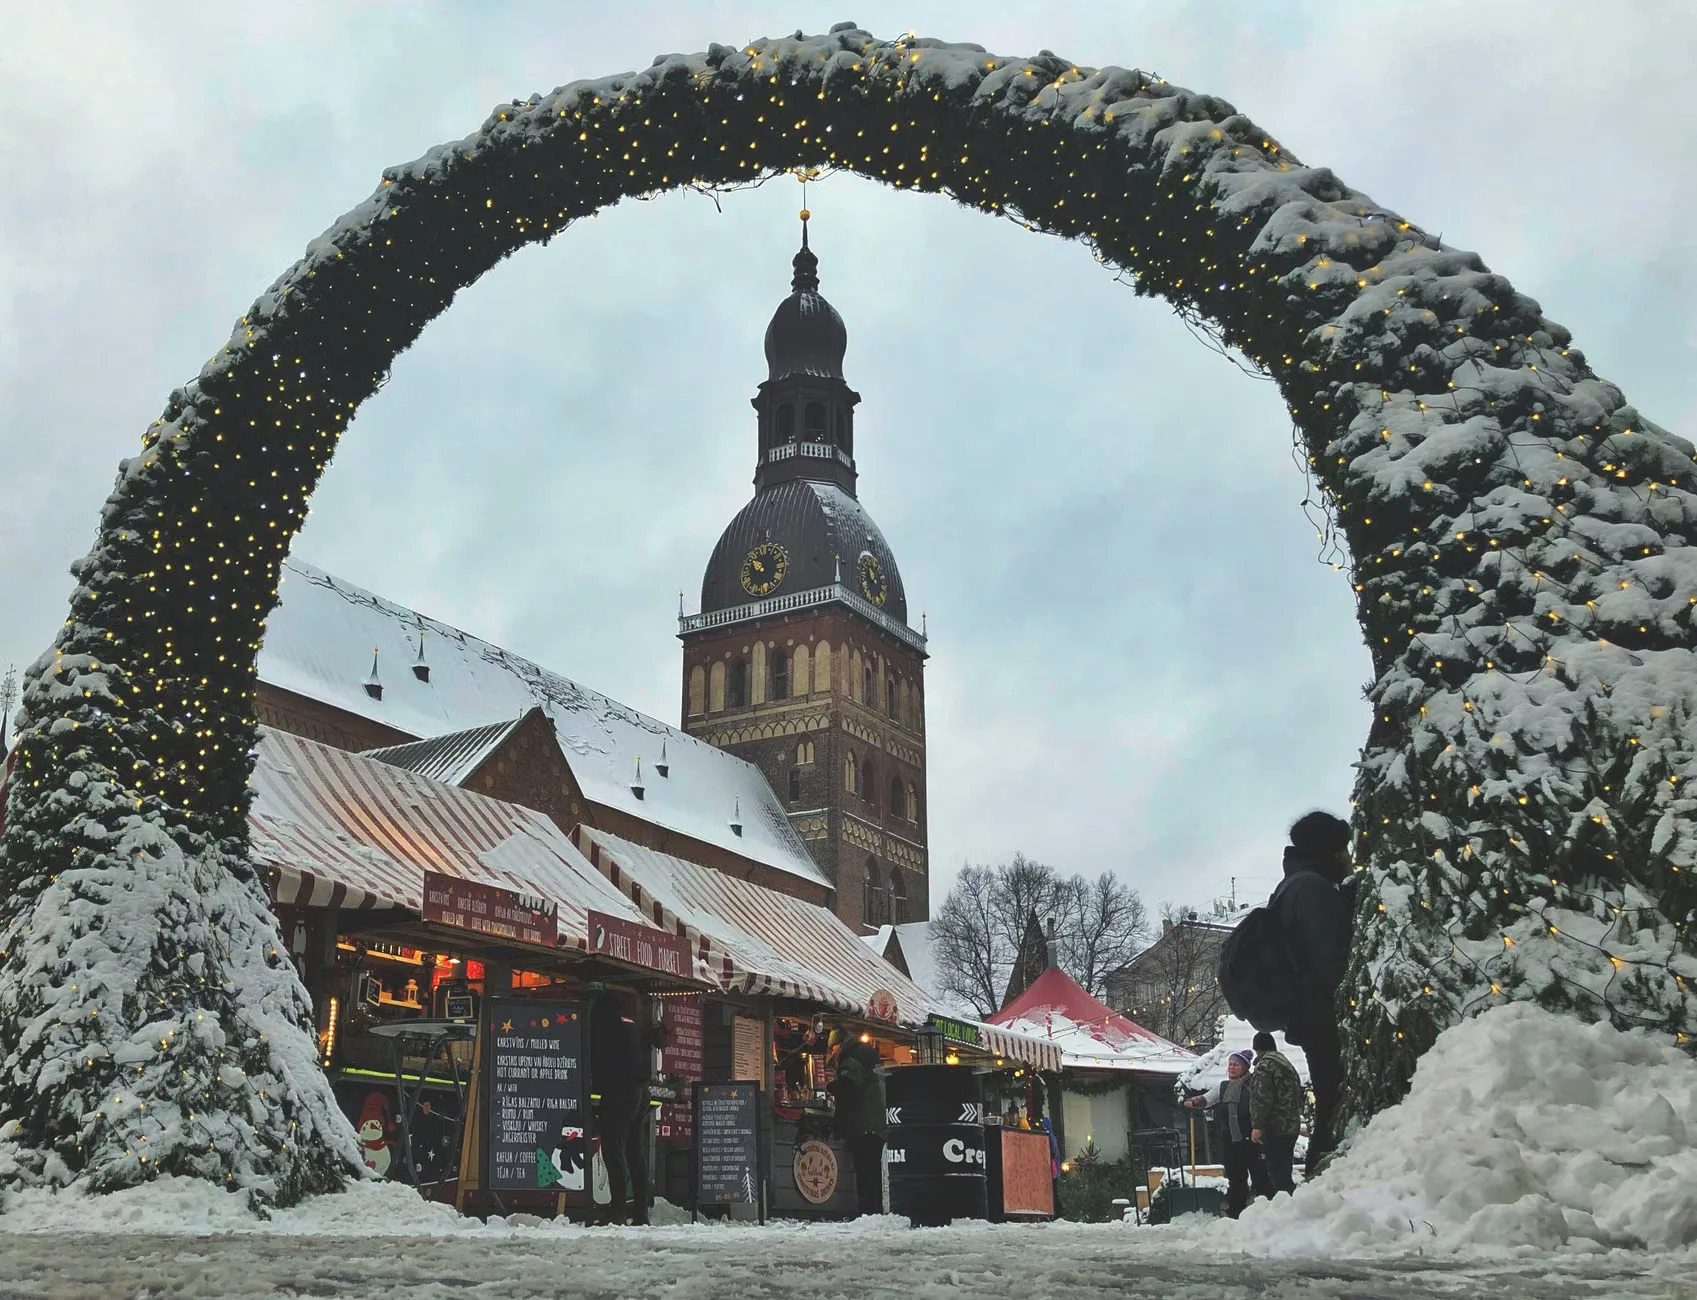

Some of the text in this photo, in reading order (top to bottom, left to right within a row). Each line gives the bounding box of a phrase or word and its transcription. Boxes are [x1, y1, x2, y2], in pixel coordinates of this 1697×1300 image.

[609, 933, 680, 974] STREET FOOD MARKET
[497, 1036, 524, 1049] KARSTVĪNS
[531, 1038, 547, 1049] MULLED
[549, 1039, 560, 1050] WINE
[497, 1067, 507, 1078] HOT
[531, 1068, 539, 1079] OR
[540, 1068, 553, 1079] APPLE
[554, 1069, 568, 1080] DRINK
[547, 1098, 558, 1109] RIGA
[559, 1098, 577, 1109] BALSAM
[502, 1108, 517, 1119] RUMU
[522, 1109, 534, 1120] RUM
[528, 1121, 548, 1132] WHISKEY
[496, 1151, 513, 1163] KAFIJA
[520, 1152, 537, 1164] COFFEE
[517, 1168, 526, 1179] TEA
